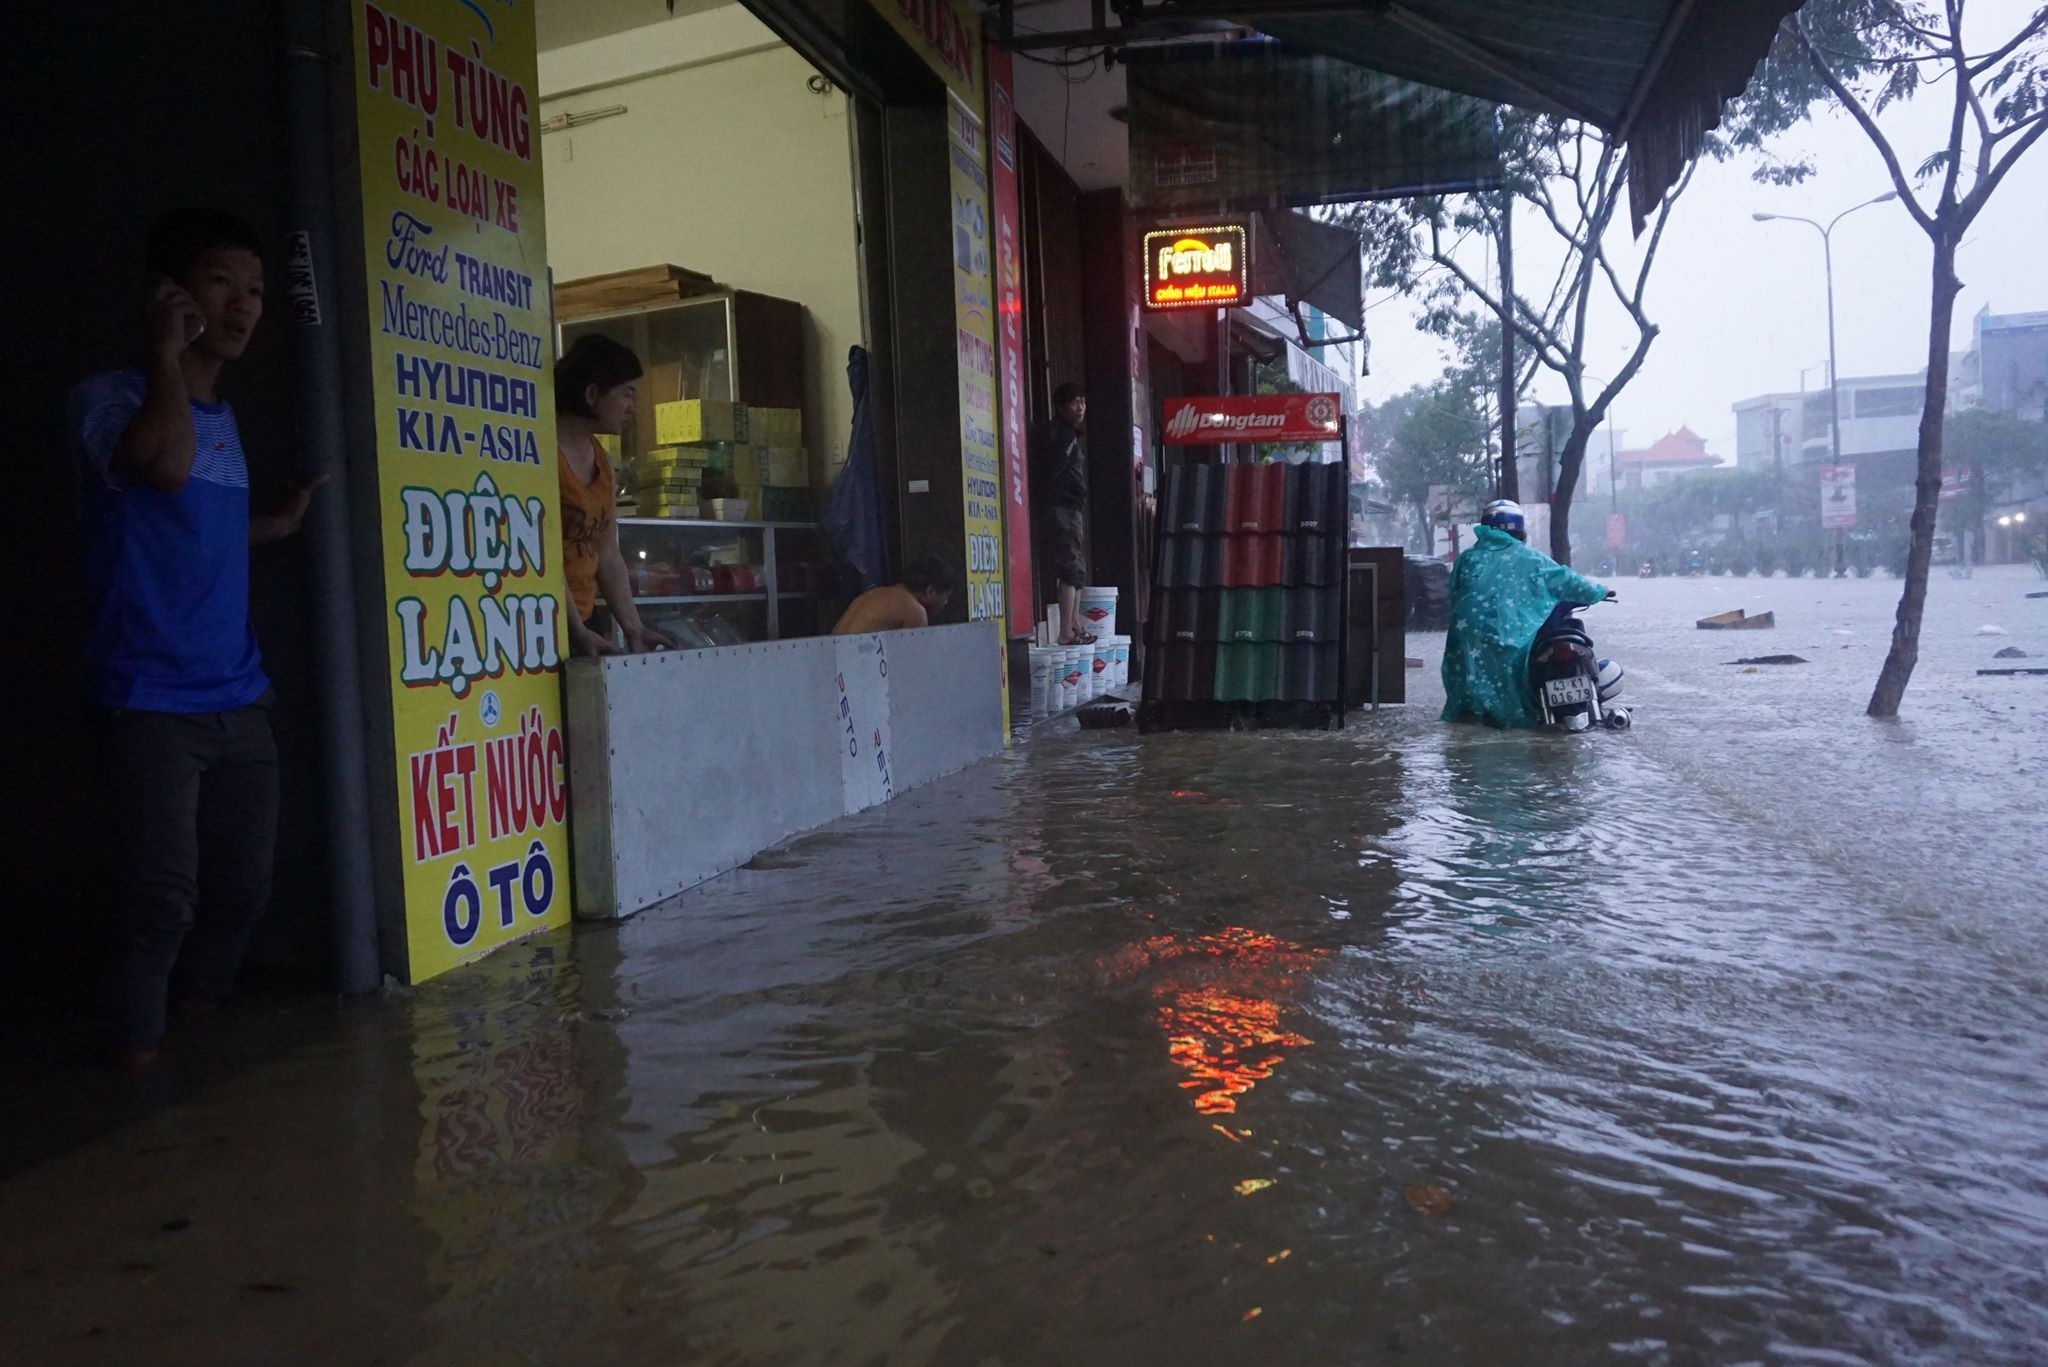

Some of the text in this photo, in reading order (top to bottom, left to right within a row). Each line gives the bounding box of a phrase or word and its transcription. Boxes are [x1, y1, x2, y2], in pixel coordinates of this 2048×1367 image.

[366, 3, 532, 160] PHỤ TÙNG
[395, 128, 518, 233] CÁC LOẠI XE
[386, 211, 449, 285] Ford
[455, 252, 532, 311] TRANSIT
[1207, 285, 1237, 297] ITALIA
[380, 280, 542, 370] Mercedes-Benz
[396, 353, 537, 419] HYUNDAI
[397, 408, 541, 465] KIA-ASIA
[1008, 347, 1024, 506] NIPPON
[401, 471, 545, 594] ĐIỆN
[396, 593, 559, 699] LẠNH
[1553, 680, 1566, 692] 43
[410, 706, 566, 861] KẾT NƯỚC
[444, 864, 480, 946] Ô
[489, 840, 554, 927] TÔ
